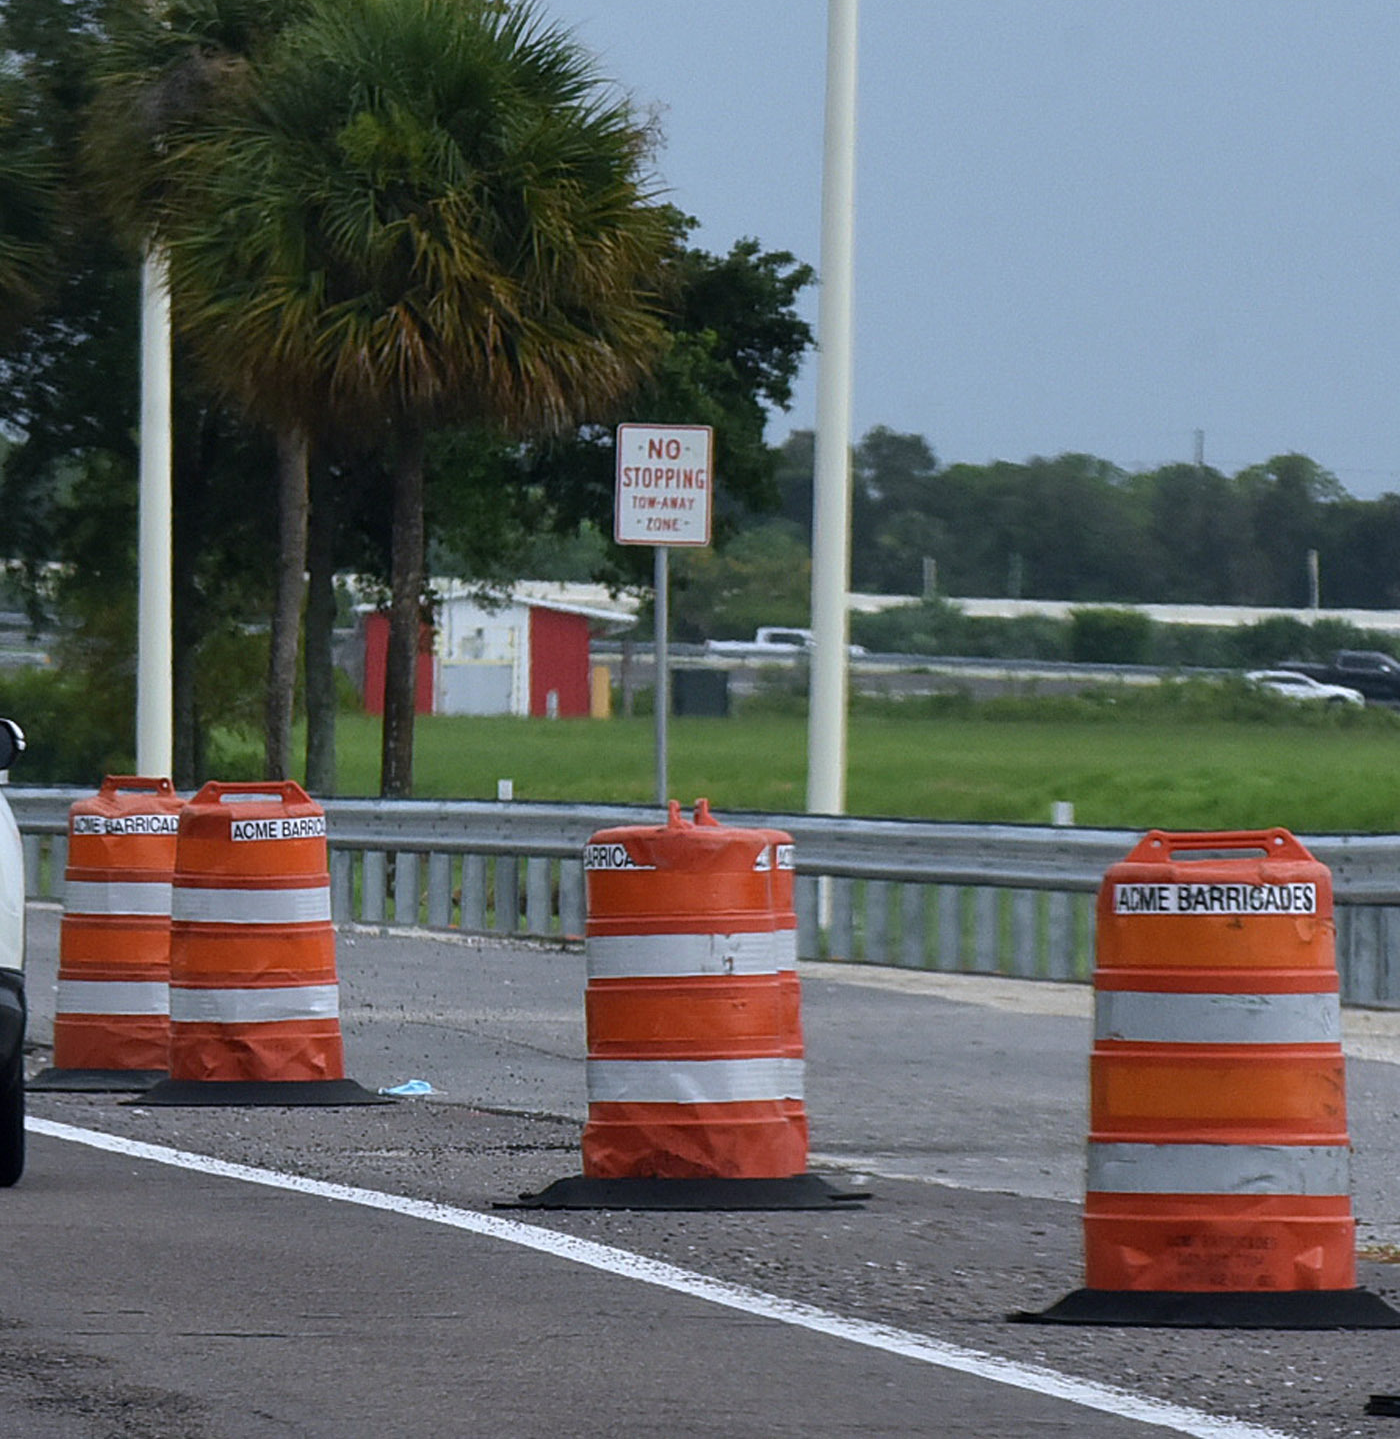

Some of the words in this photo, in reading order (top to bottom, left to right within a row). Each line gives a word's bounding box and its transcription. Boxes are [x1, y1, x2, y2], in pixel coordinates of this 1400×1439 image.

[648, 438, 681, 460] NO
[623, 467, 705, 489] STOPPING
[632, 496, 695, 510] TOW-AWAY
[646, 517, 680, 532] ZONE
[233, 821, 278, 839] ACME
[1118, 886, 1171, 912] ACME
[1177, 885, 1314, 912] BARRICADES
